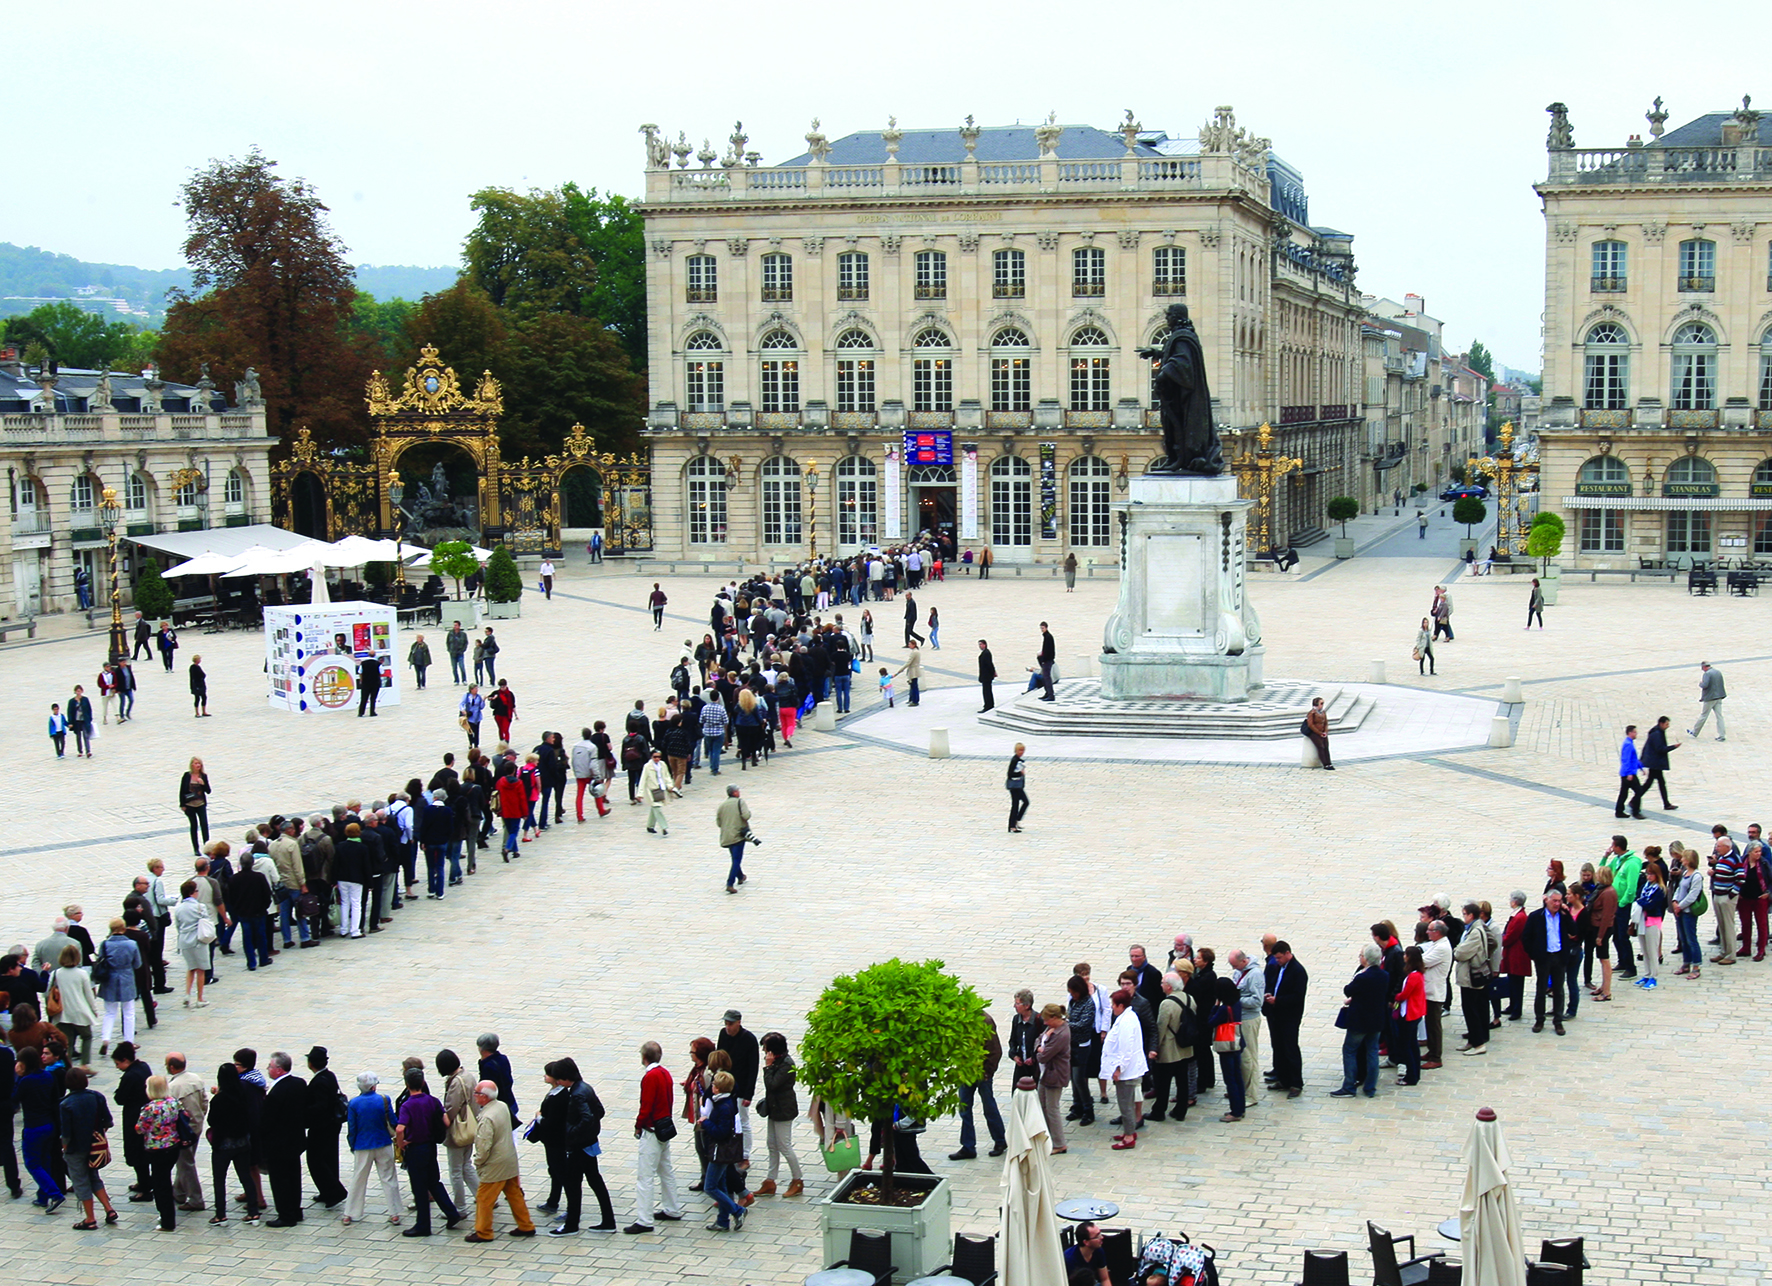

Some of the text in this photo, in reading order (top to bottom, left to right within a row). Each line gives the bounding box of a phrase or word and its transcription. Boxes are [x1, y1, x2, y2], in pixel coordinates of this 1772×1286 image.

[953, 212, 1003, 222] LORRAINE
[1579, 485, 1629, 493] RESTAURANT
[1670, 485, 1712, 494] STANISLAS
